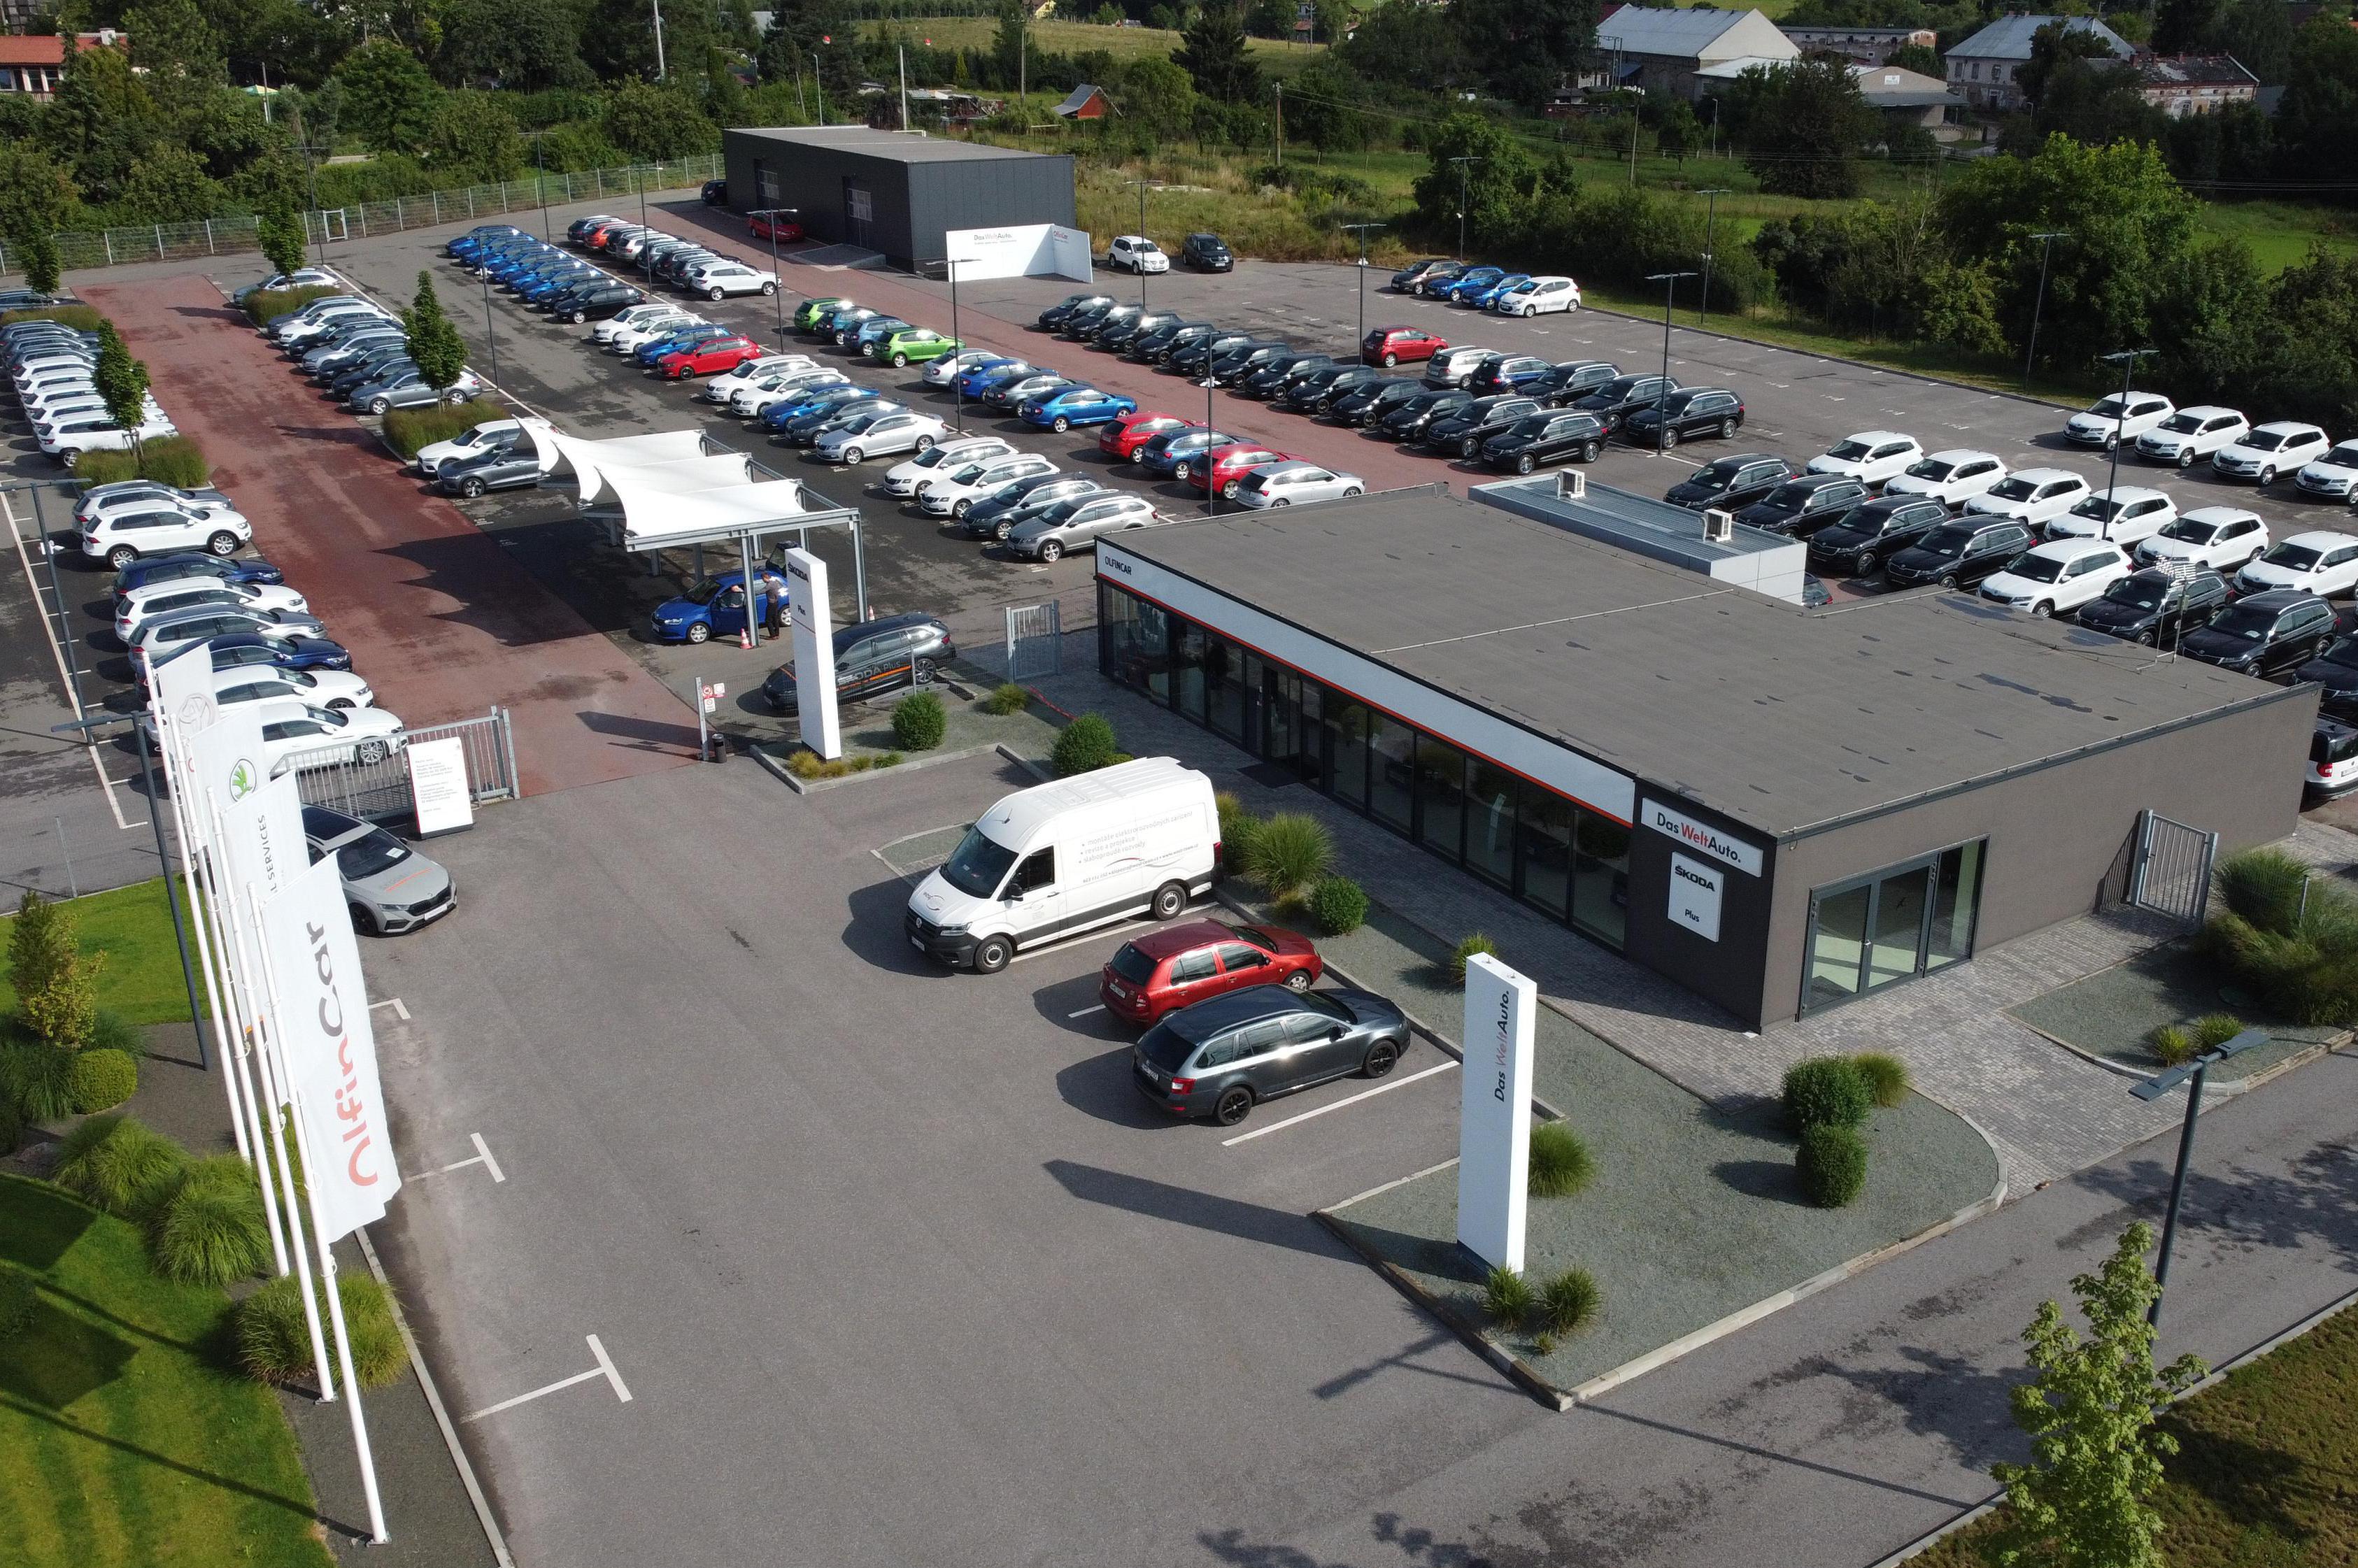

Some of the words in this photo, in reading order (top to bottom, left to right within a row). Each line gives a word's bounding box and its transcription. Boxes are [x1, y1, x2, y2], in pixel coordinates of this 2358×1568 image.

[788, 562, 809, 583] ŠKODA
[257, 814, 276, 881] SERVICES
[1657, 811, 1679, 834] Das
[1681, 822, 1741, 862] WeltAuto.
[1675, 864, 1715, 892] ŠKODA
[1684, 908, 1700, 922] Plus
[1496, 990, 1510, 1067] WeltAuto.
[1494, 1071, 1506, 1103] Das
